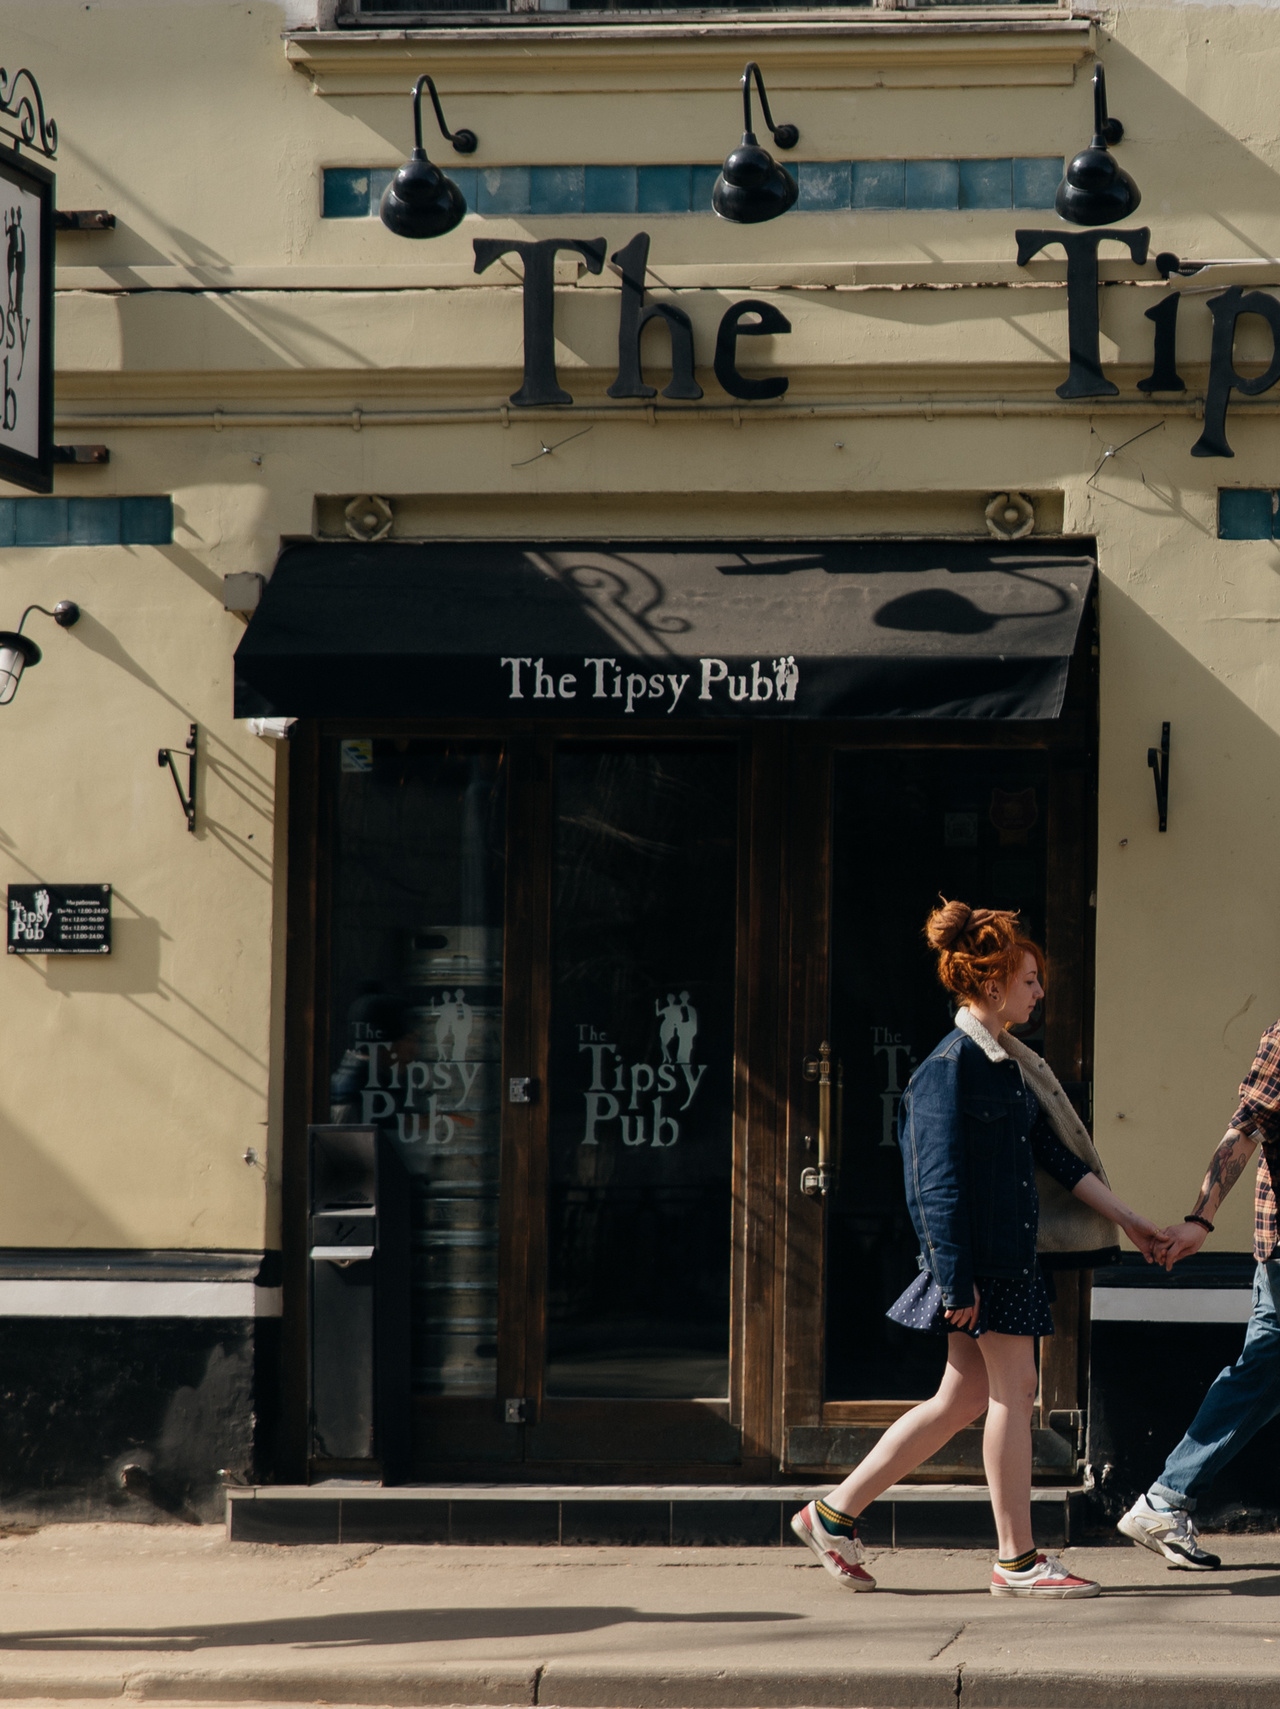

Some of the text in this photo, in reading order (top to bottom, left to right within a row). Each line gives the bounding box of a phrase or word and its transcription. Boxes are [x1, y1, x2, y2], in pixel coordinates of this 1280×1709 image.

[472, 231, 792, 406] The
[501, 657, 774, 713] The Tipsy Pub
[11, 906, 53, 928] Tipsy
[13, 923, 45, 940] Pub
[351, 1021, 384, 1039] The
[575, 1023, 608, 1041] The
[870, 1026, 902, 1043] The
[354, 1041, 482, 1108] Tipsy
[578, 1043, 708, 1111] Tipsy
[360, 1090, 455, 1145] Pub
[580, 1092, 680, 1147] Pub
